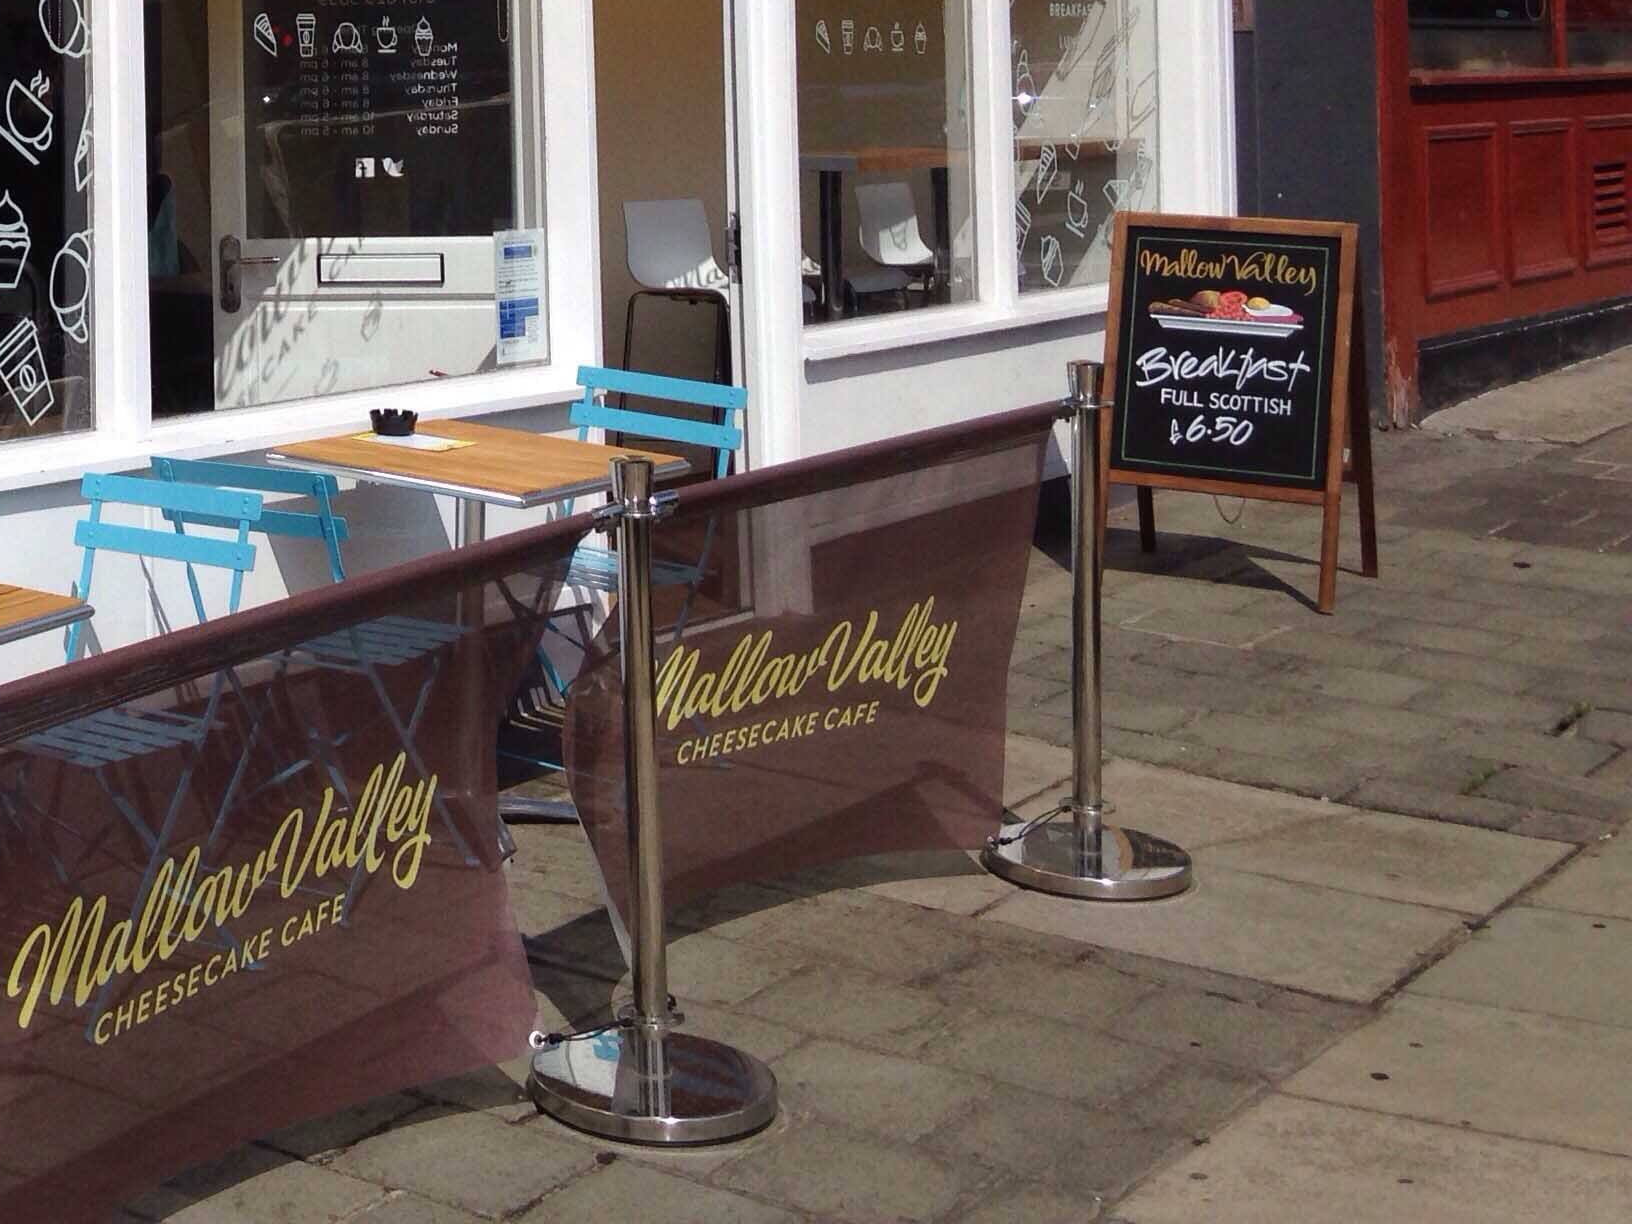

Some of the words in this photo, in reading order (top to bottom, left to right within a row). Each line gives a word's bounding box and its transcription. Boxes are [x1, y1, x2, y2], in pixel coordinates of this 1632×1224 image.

[1140, 249, 1226, 280] Mallow
[1225, 251, 1317, 296] Valley
[1160, 387, 1204, 408] FULL
[1208, 391, 1292, 416] SCOTTISH
[818, 595, 958, 708] Valley
[677, 712, 818, 765] CHEESECAKE
[824, 700, 880, 731] CAFE
[7, 845, 269, 1029] Mallow
[266, 750, 438, 898] Valley
[94, 929, 273, 1046] CHEESECAKE
[280, 892, 346, 947] CAFE
